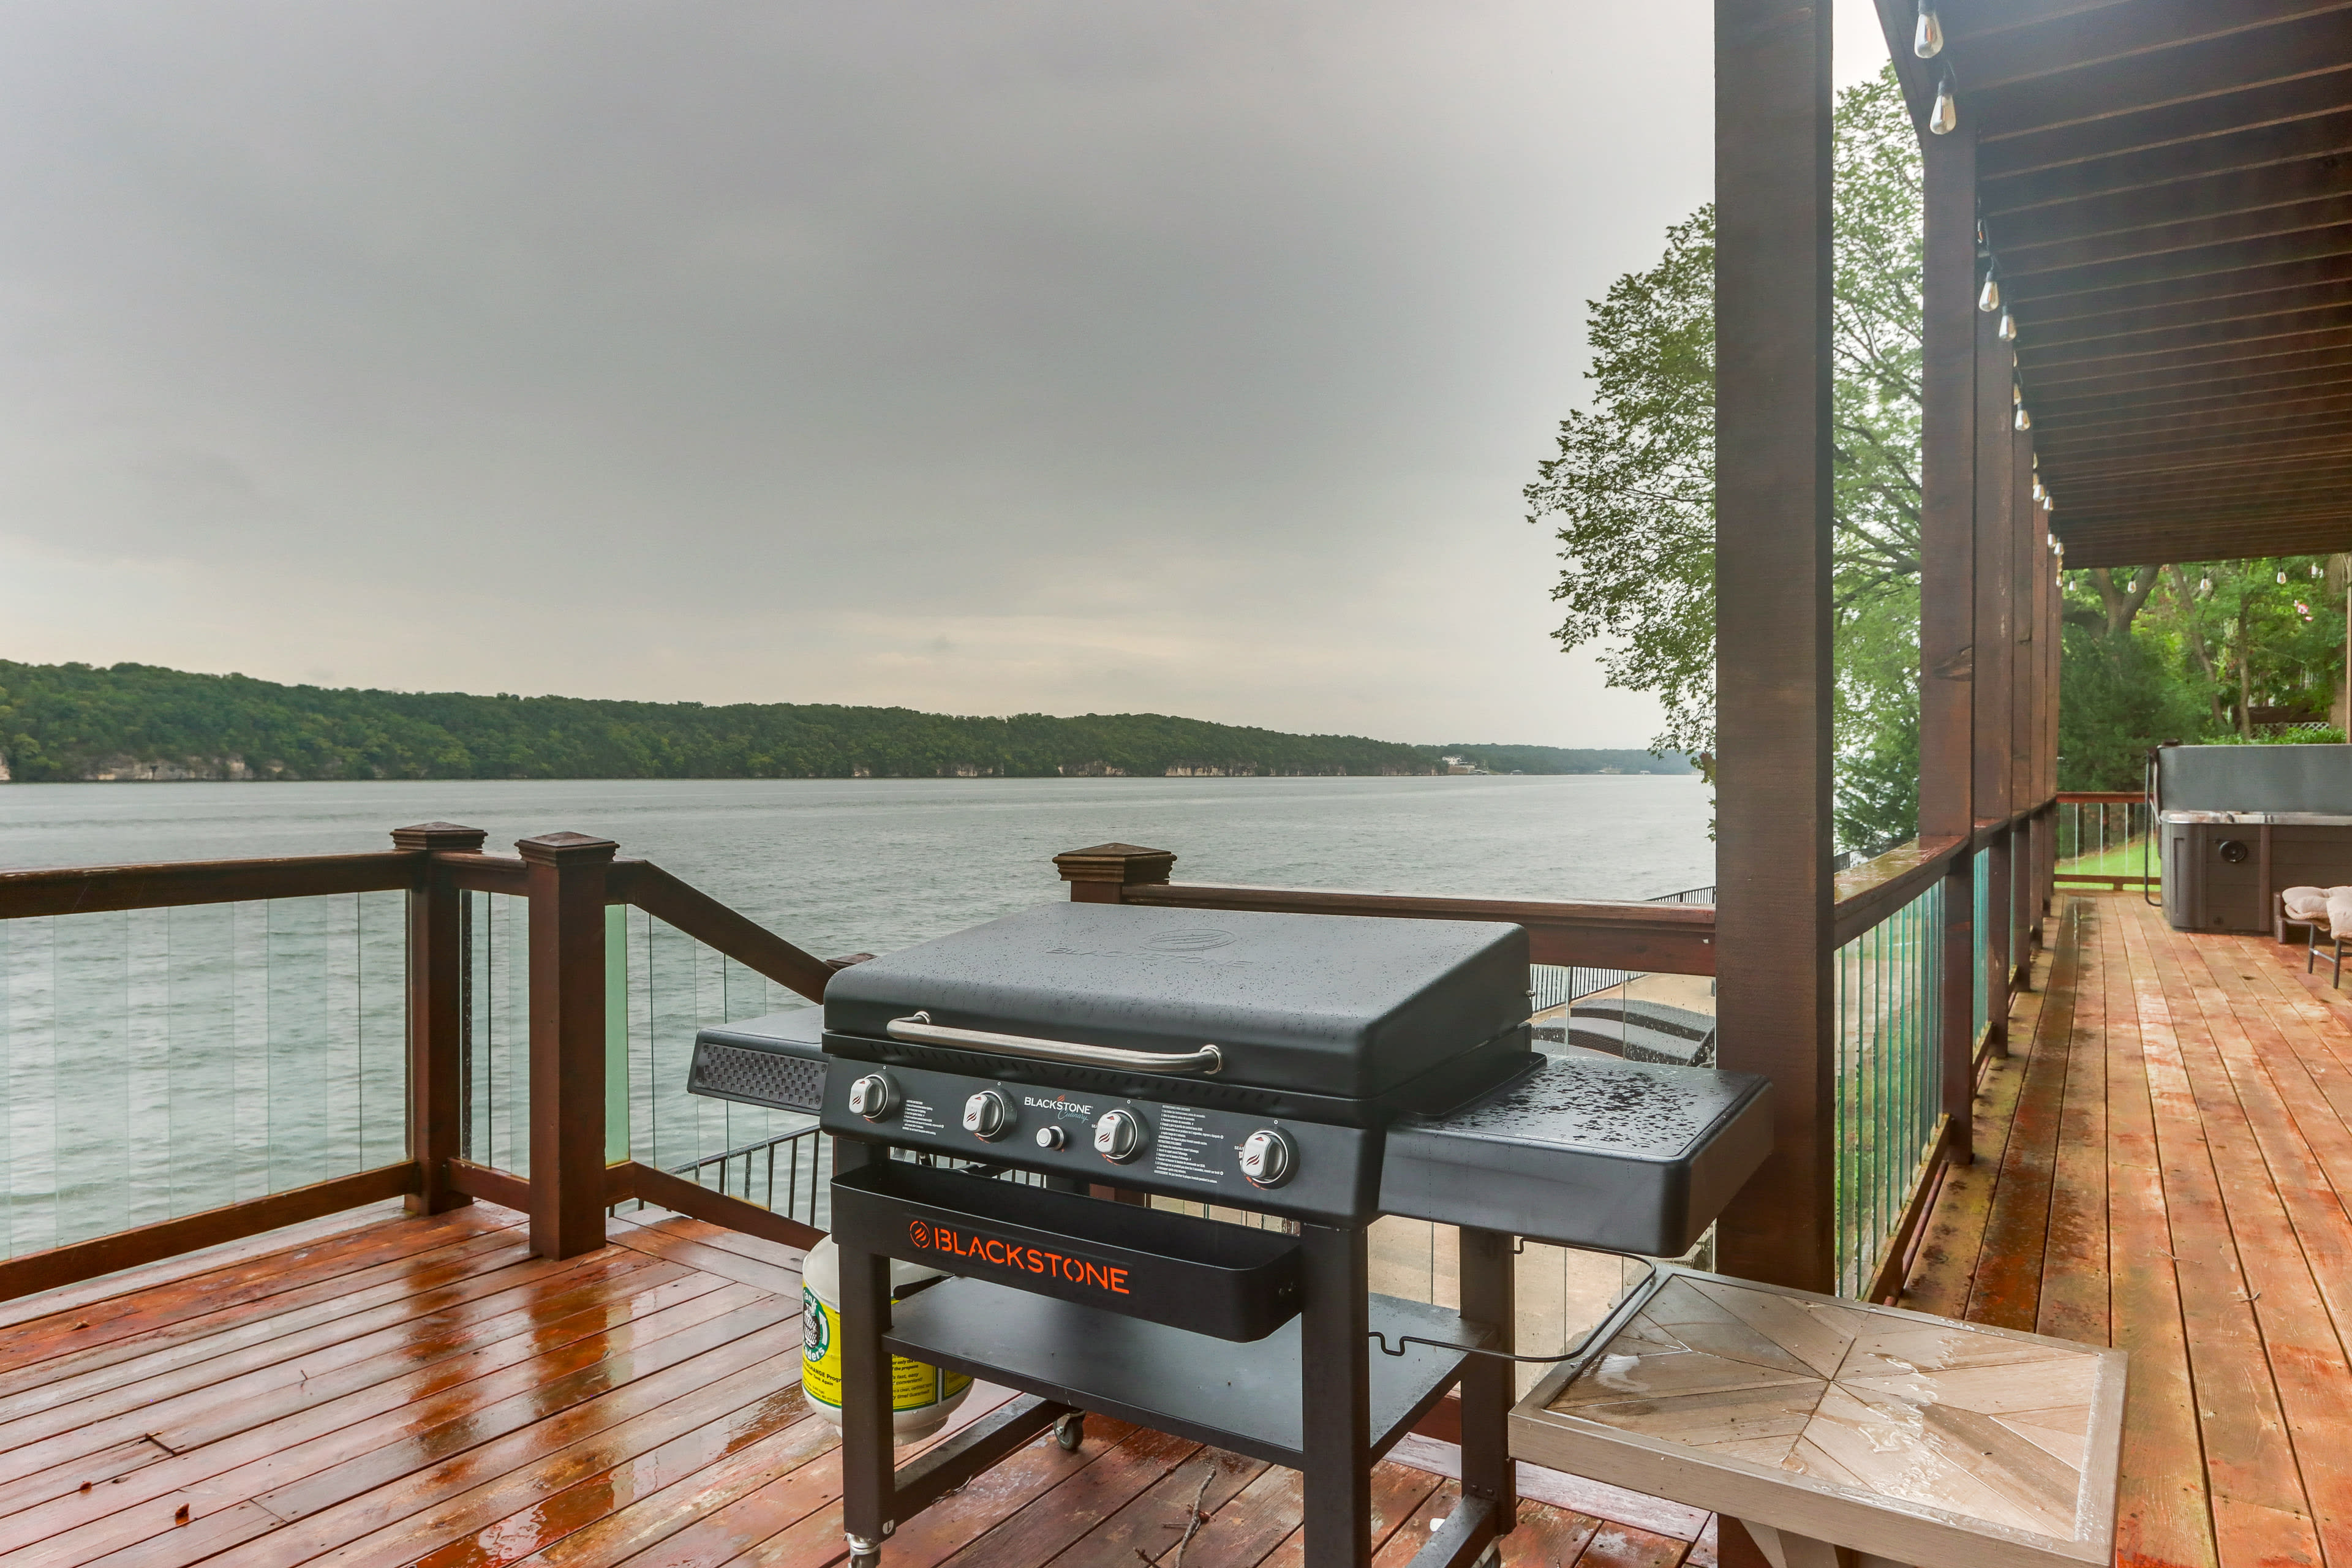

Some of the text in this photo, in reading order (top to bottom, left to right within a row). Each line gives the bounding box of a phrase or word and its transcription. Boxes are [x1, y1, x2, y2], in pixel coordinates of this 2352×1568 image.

[1046, 947, 1255, 968] BLACKSTONE
[1024, 1096, 1091, 1115] BLACKSTONE
[1057, 1109, 1089, 1124] Culinary
[934, 1227, 1130, 1294] BLACKSTONE
[826, 1374, 842, 1383] Progr
